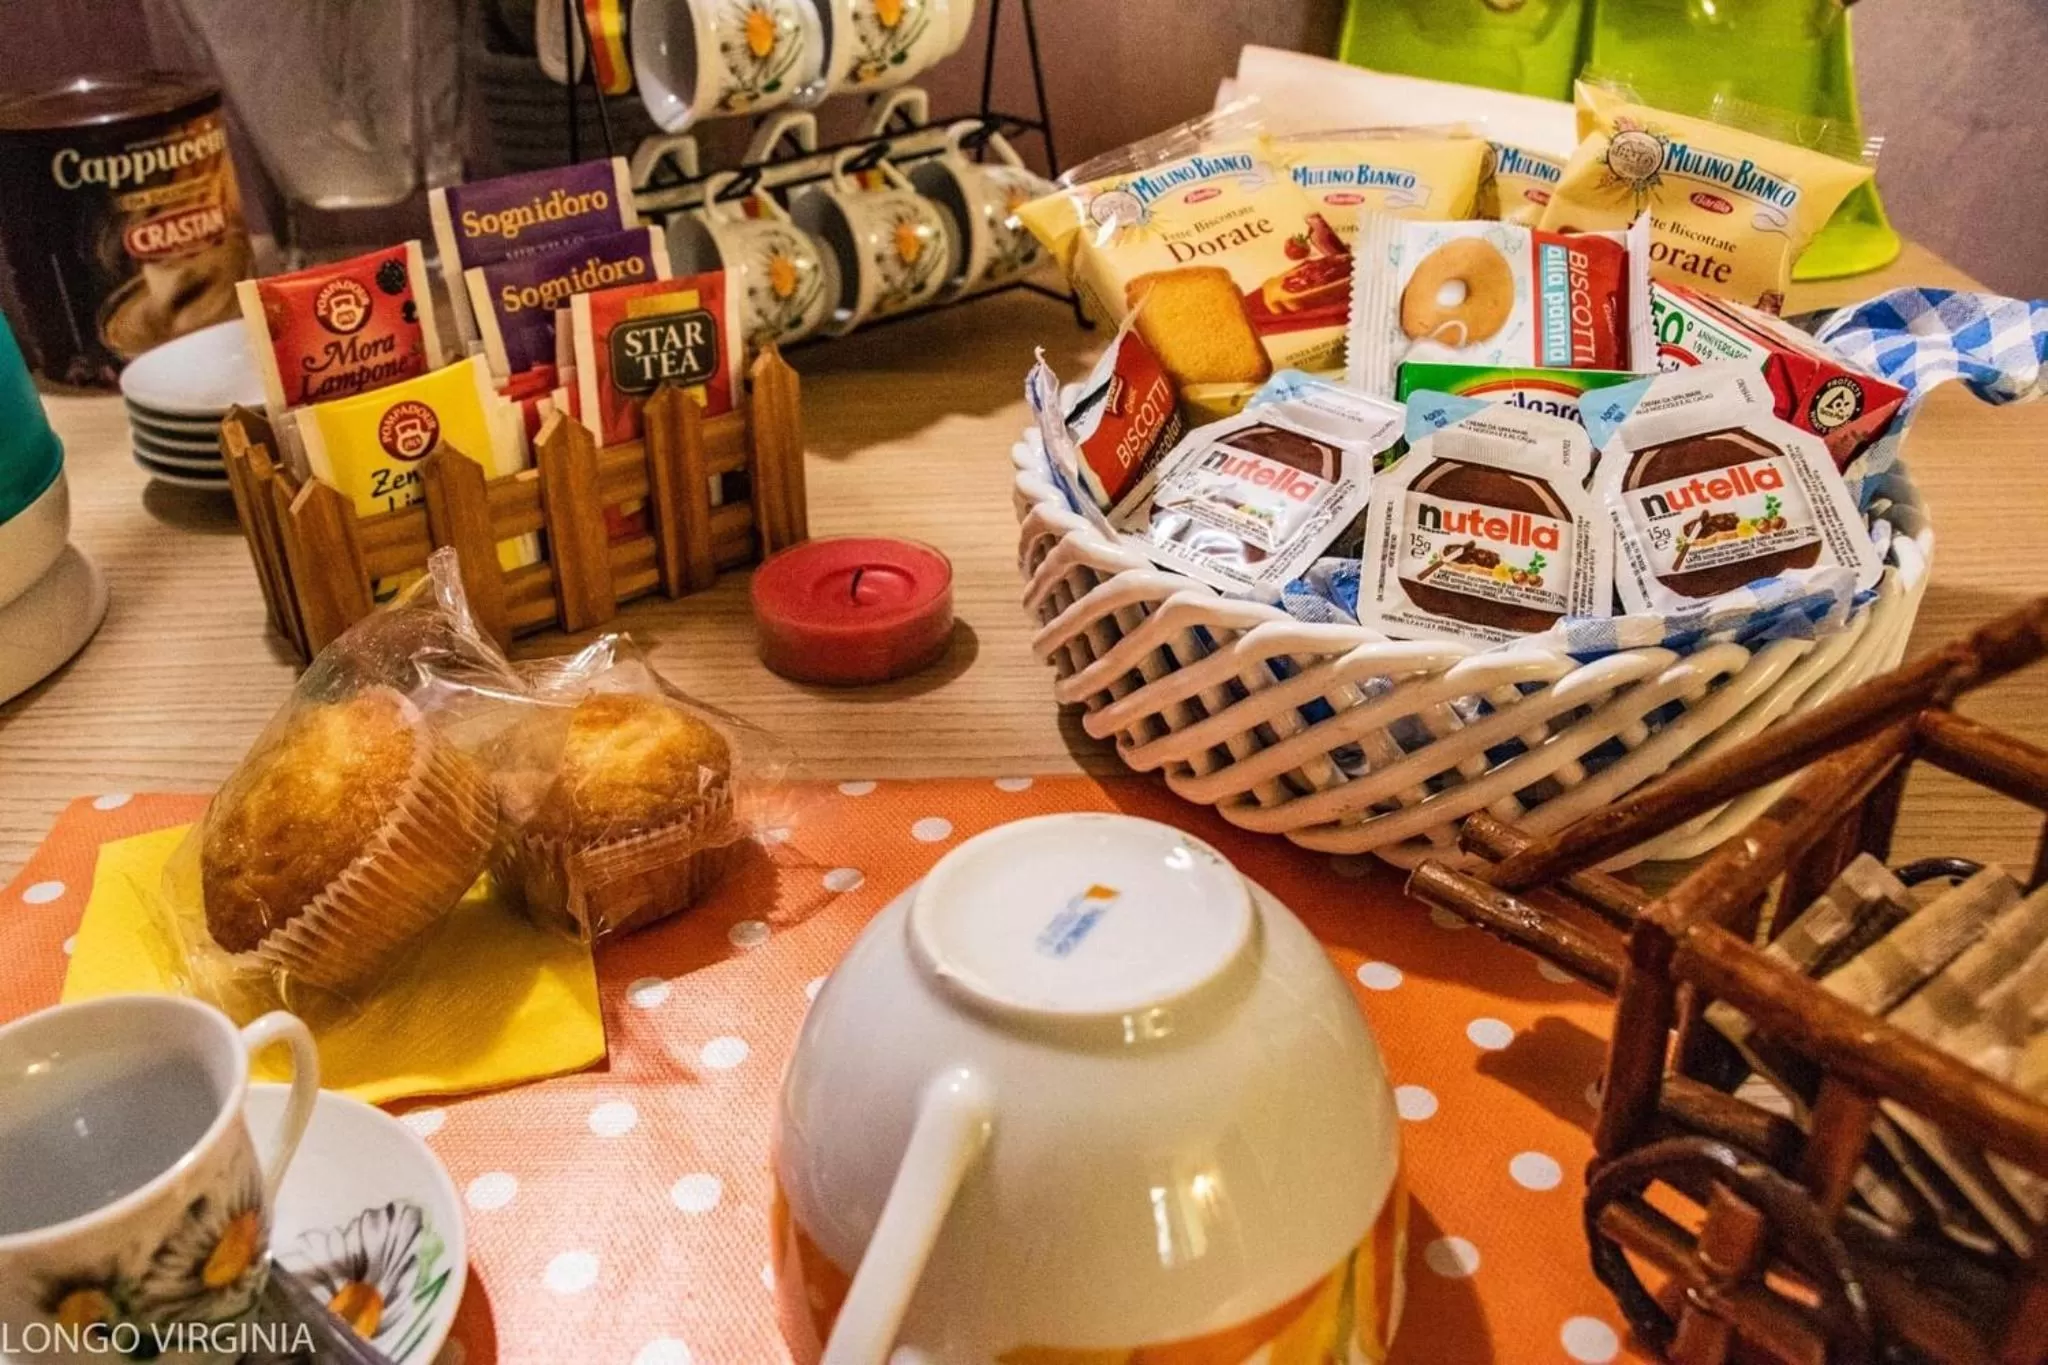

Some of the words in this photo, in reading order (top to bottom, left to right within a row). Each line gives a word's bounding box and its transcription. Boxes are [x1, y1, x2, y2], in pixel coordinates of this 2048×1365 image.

[1132, 164, 1196, 203] MULINO
[1192, 154, 1253, 179] BIANCO
[1292, 166, 1354, 187] MULINO
[1356, 163, 1416, 189] BIANCO
[1500, 147, 1561, 183] MULINO
[1664, 142, 1734, 183] MULINO
[1732, 158, 1797, 208] BIANCO
[1165, 218, 1274, 263] Dorate
[1669, 221, 1738, 253] Biscottate
[1547, 246, 1568, 286] alla
[1640, 234, 1733, 284] orate
[316, 279, 371, 317] POMPADOUR
[1569, 250, 1596, 363] BISCOTTI
[624, 321, 705, 357] STAR
[1543, 291, 1566, 362] panna
[302, 333, 396, 373] Mora
[635, 347, 701, 380] TEA
[381, 403, 437, 444] POMPADOUR
[1116, 375, 1170, 470] BISCOTTI
[1200, 449, 1317, 503] nutella
[1640, 465, 1784, 518] nutella
[1409, 532, 1432, 553] 15g
[1418, 502, 1560, 551] nutella
[1646, 525, 1671, 541] 15g
